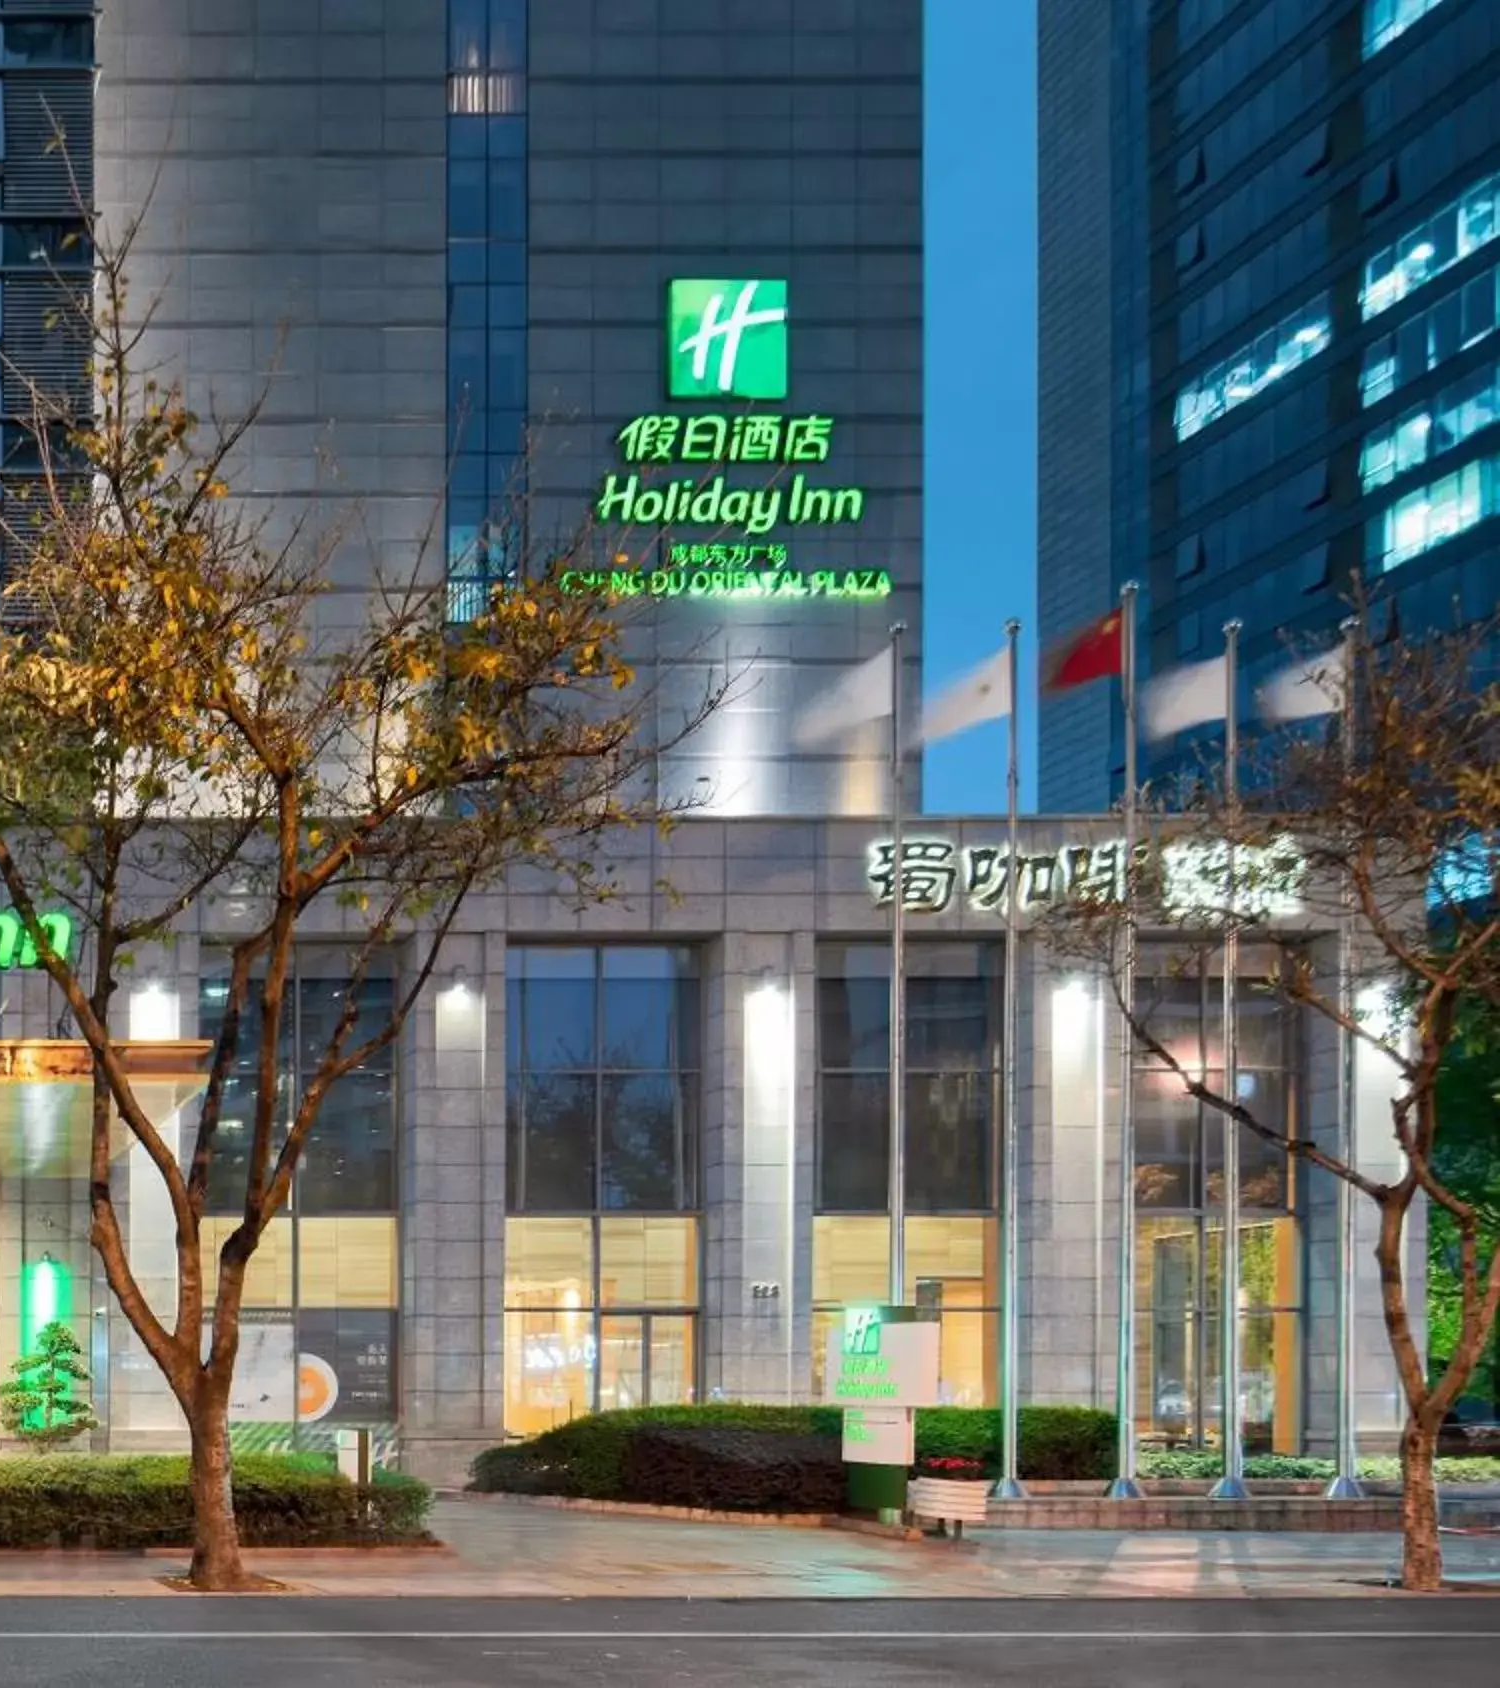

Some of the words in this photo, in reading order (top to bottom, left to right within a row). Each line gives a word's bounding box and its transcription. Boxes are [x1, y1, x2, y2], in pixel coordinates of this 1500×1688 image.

[616, 414, 833, 462] 假日酒店
[599, 474, 780, 533] Holiday
[788, 474, 863, 522] Inn
[669, 544, 788, 567] 成都东方广场
[651, 571, 686, 596] DU
[690, 571, 809, 597] ORIENTAL
[811, 571, 891, 597] PLAZA
